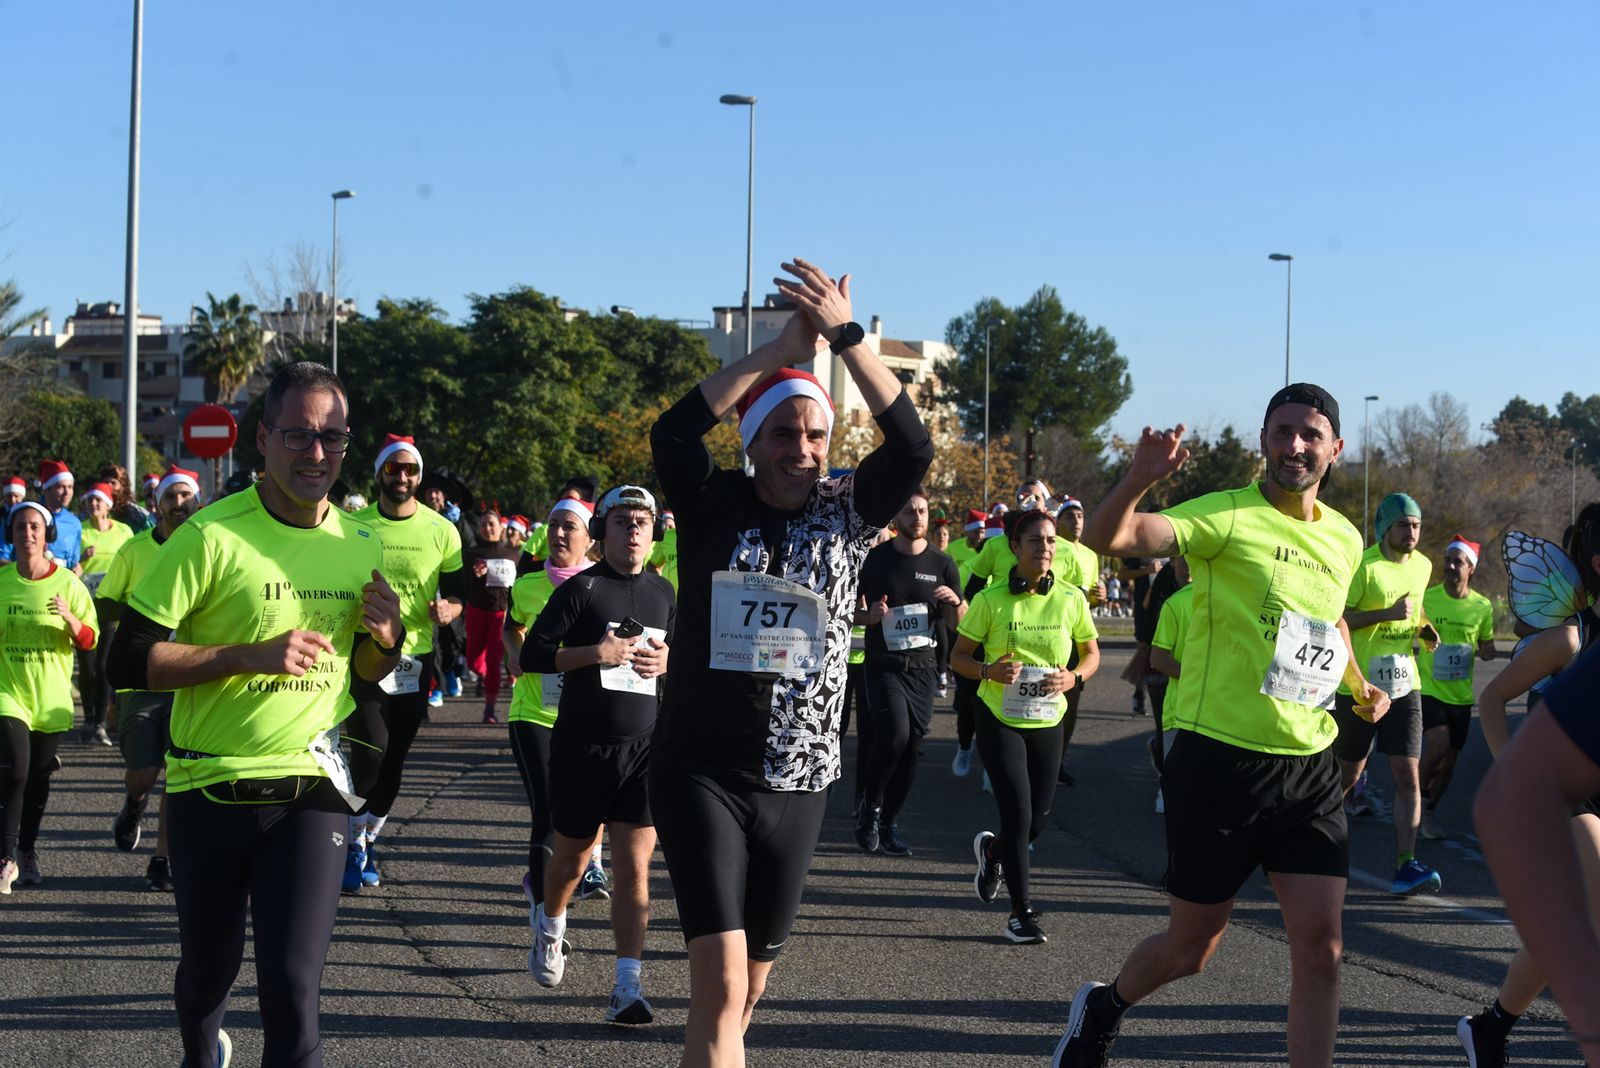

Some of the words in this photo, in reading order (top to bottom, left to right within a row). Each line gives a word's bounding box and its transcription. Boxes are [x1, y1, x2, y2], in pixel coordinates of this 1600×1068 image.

[260, 581, 291, 600] 41º
[291, 589, 355, 600] ANIVERSARIO
[741, 600, 798, 628] 757
[1259, 612, 1281, 626] SA
[895, 617, 918, 631] 409
[724, 652, 754, 660] IMDECO
[1295, 643, 1334, 671] 472
[1448, 656, 1461, 665] 13
[1377, 667, 1408, 680] 1188
[248, 680, 331, 693] CORDOBESA
[1019, 683, 1048, 697] 535
